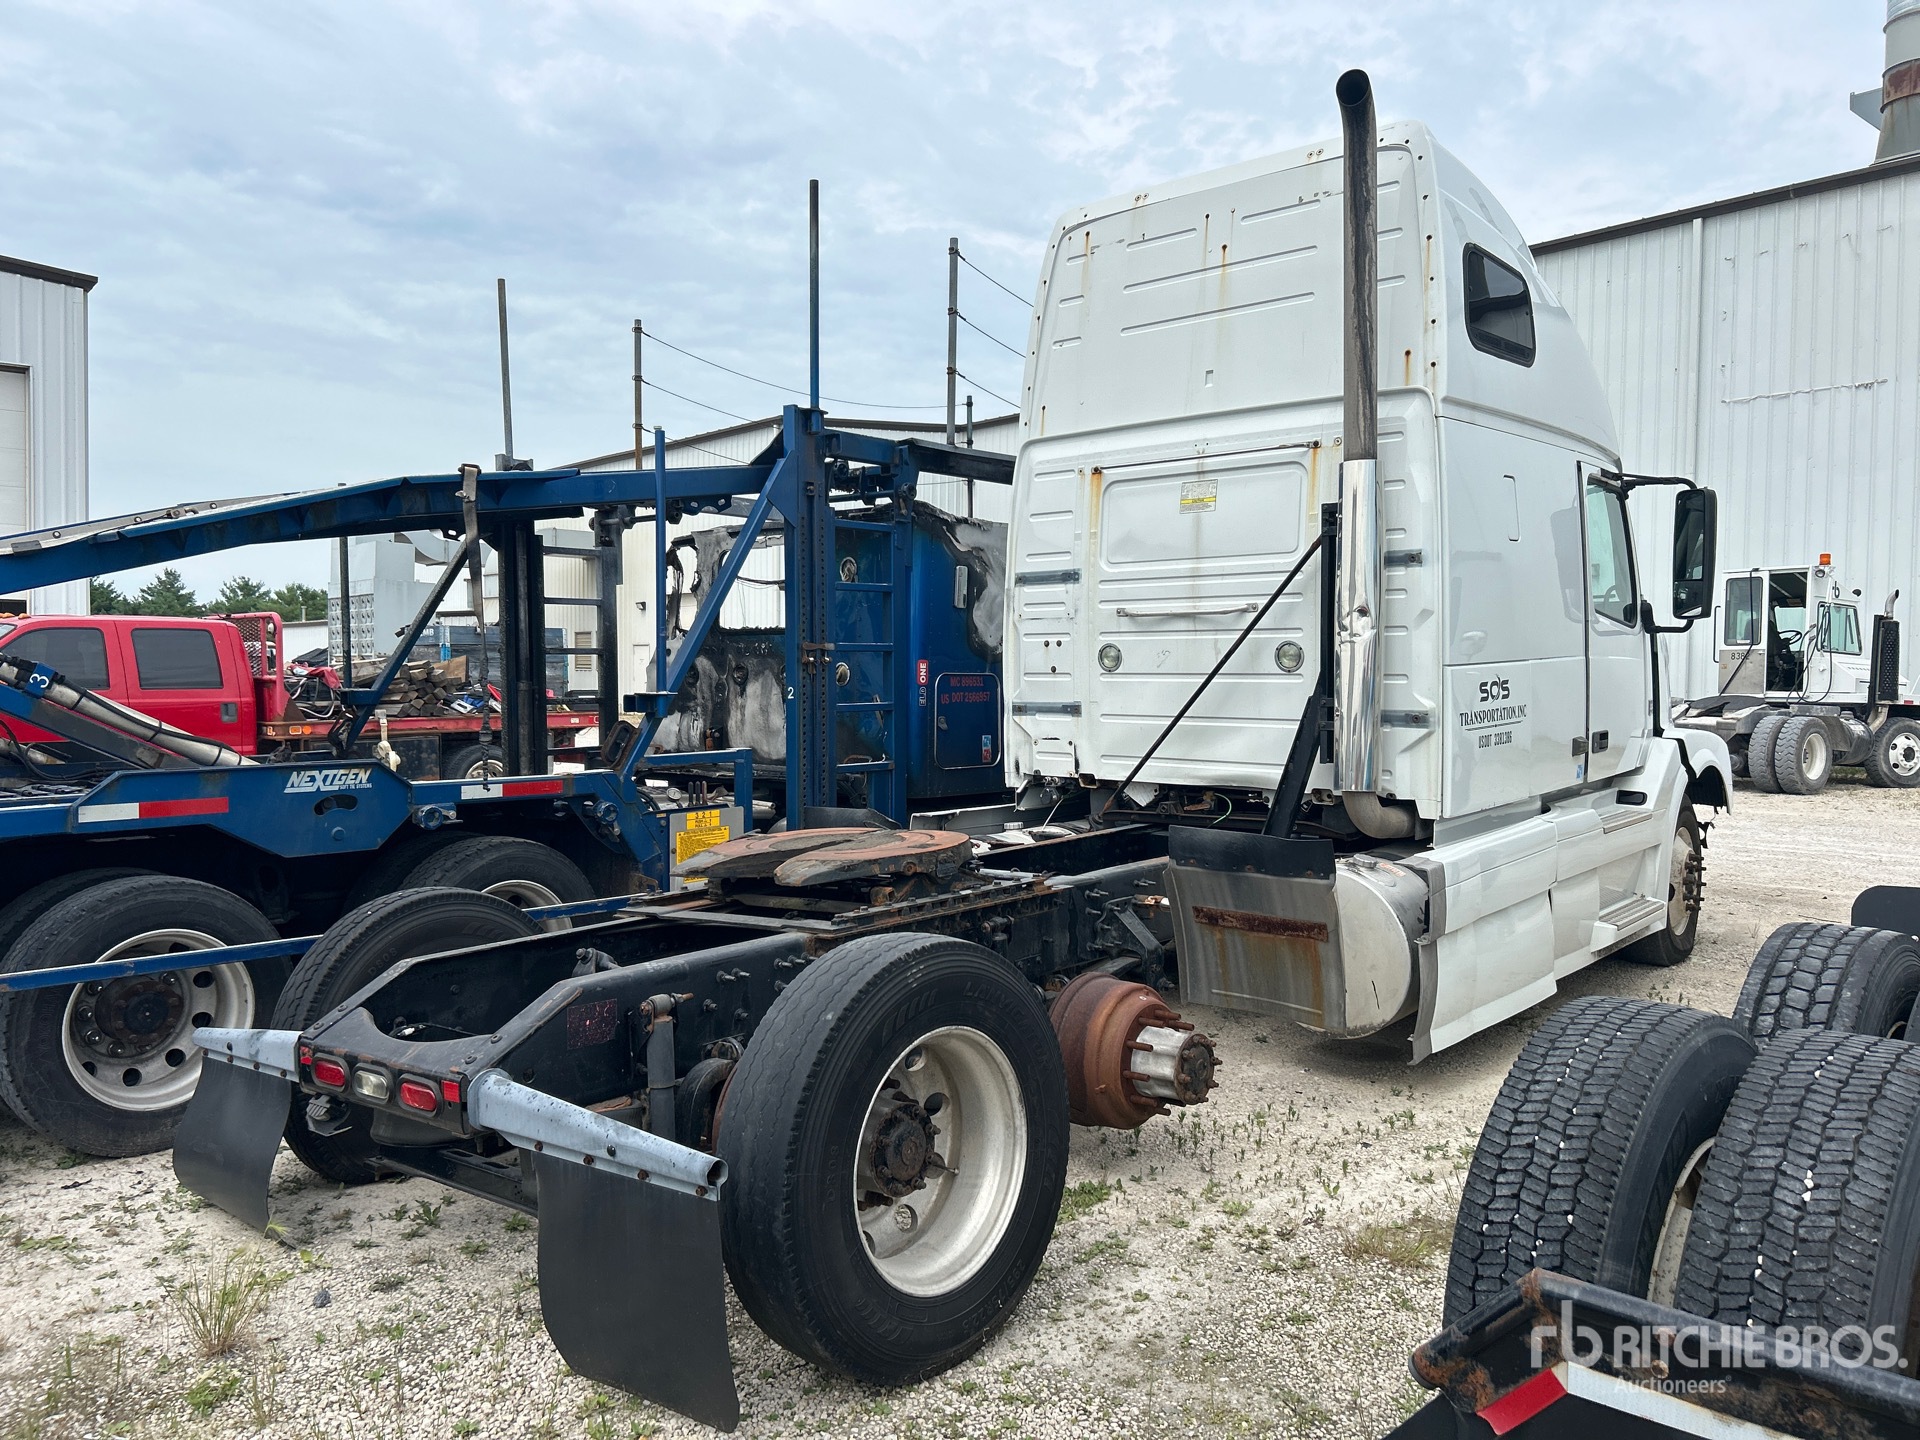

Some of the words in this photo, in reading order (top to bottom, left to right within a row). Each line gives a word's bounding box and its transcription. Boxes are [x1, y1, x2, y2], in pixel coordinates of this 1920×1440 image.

[29, 673, 50, 688] 3
[919, 662, 927, 684] ONE
[787, 686, 795, 699] 2
[940, 693, 950, 704] US
[951, 691, 964, 703] DOT
[1479, 676, 1511, 703] SOS
[1478, 733, 1493, 749] USDOT
[283, 769, 372, 793] NEXTGEN
